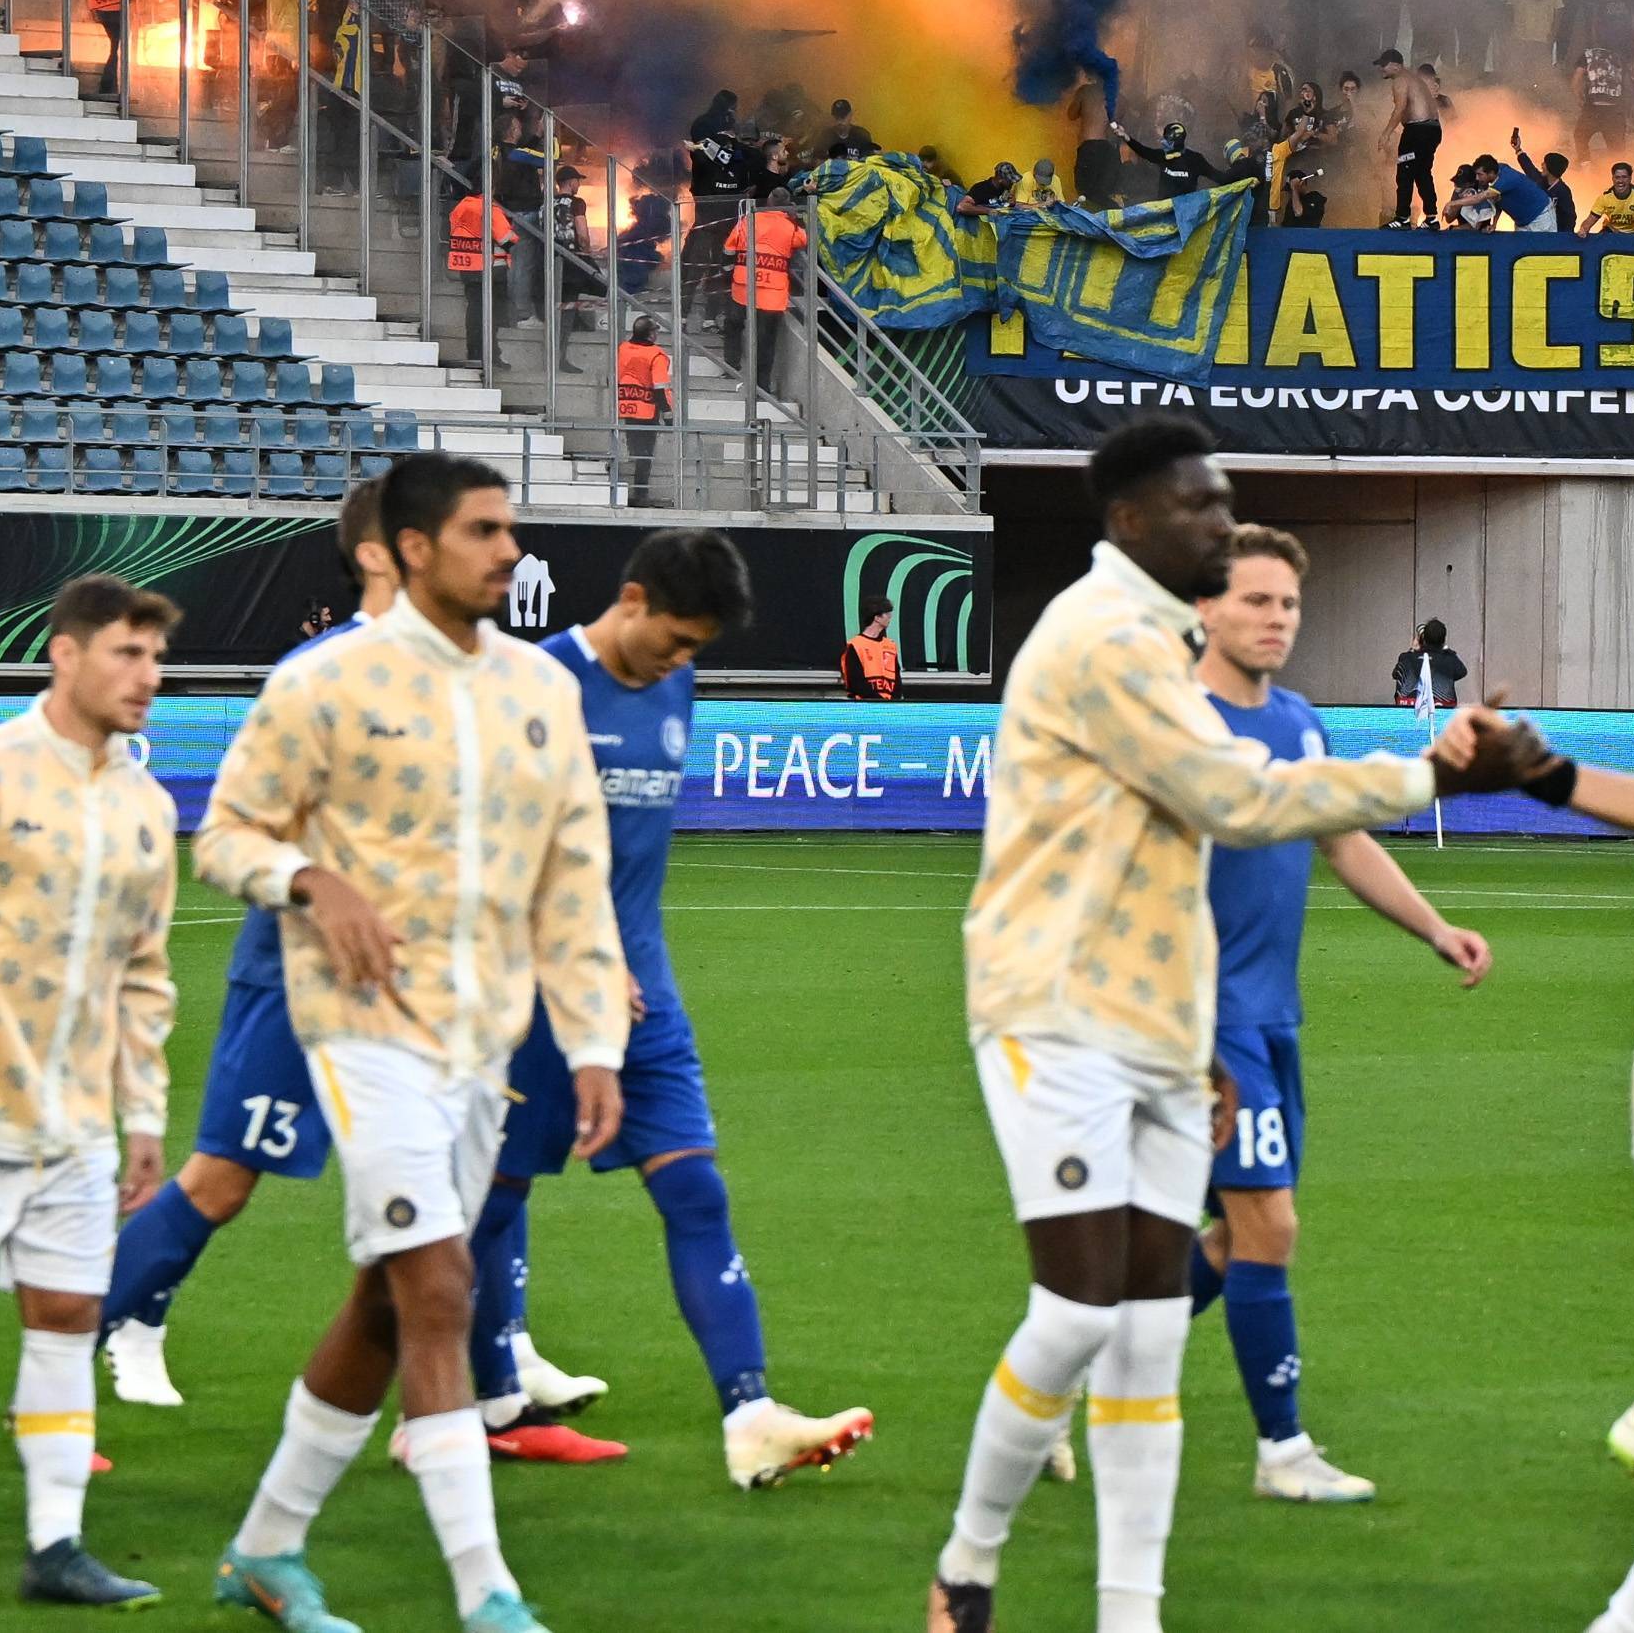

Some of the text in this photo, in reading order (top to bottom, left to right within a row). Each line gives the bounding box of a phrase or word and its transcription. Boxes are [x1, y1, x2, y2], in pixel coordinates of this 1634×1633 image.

[452, 255, 471, 267] 319
[736, 252, 788, 269] STWAR
[713, 732, 885, 799] PEACE
[241, 1094, 301, 1159] 13
[1236, 1107, 1287, 1168] 18
